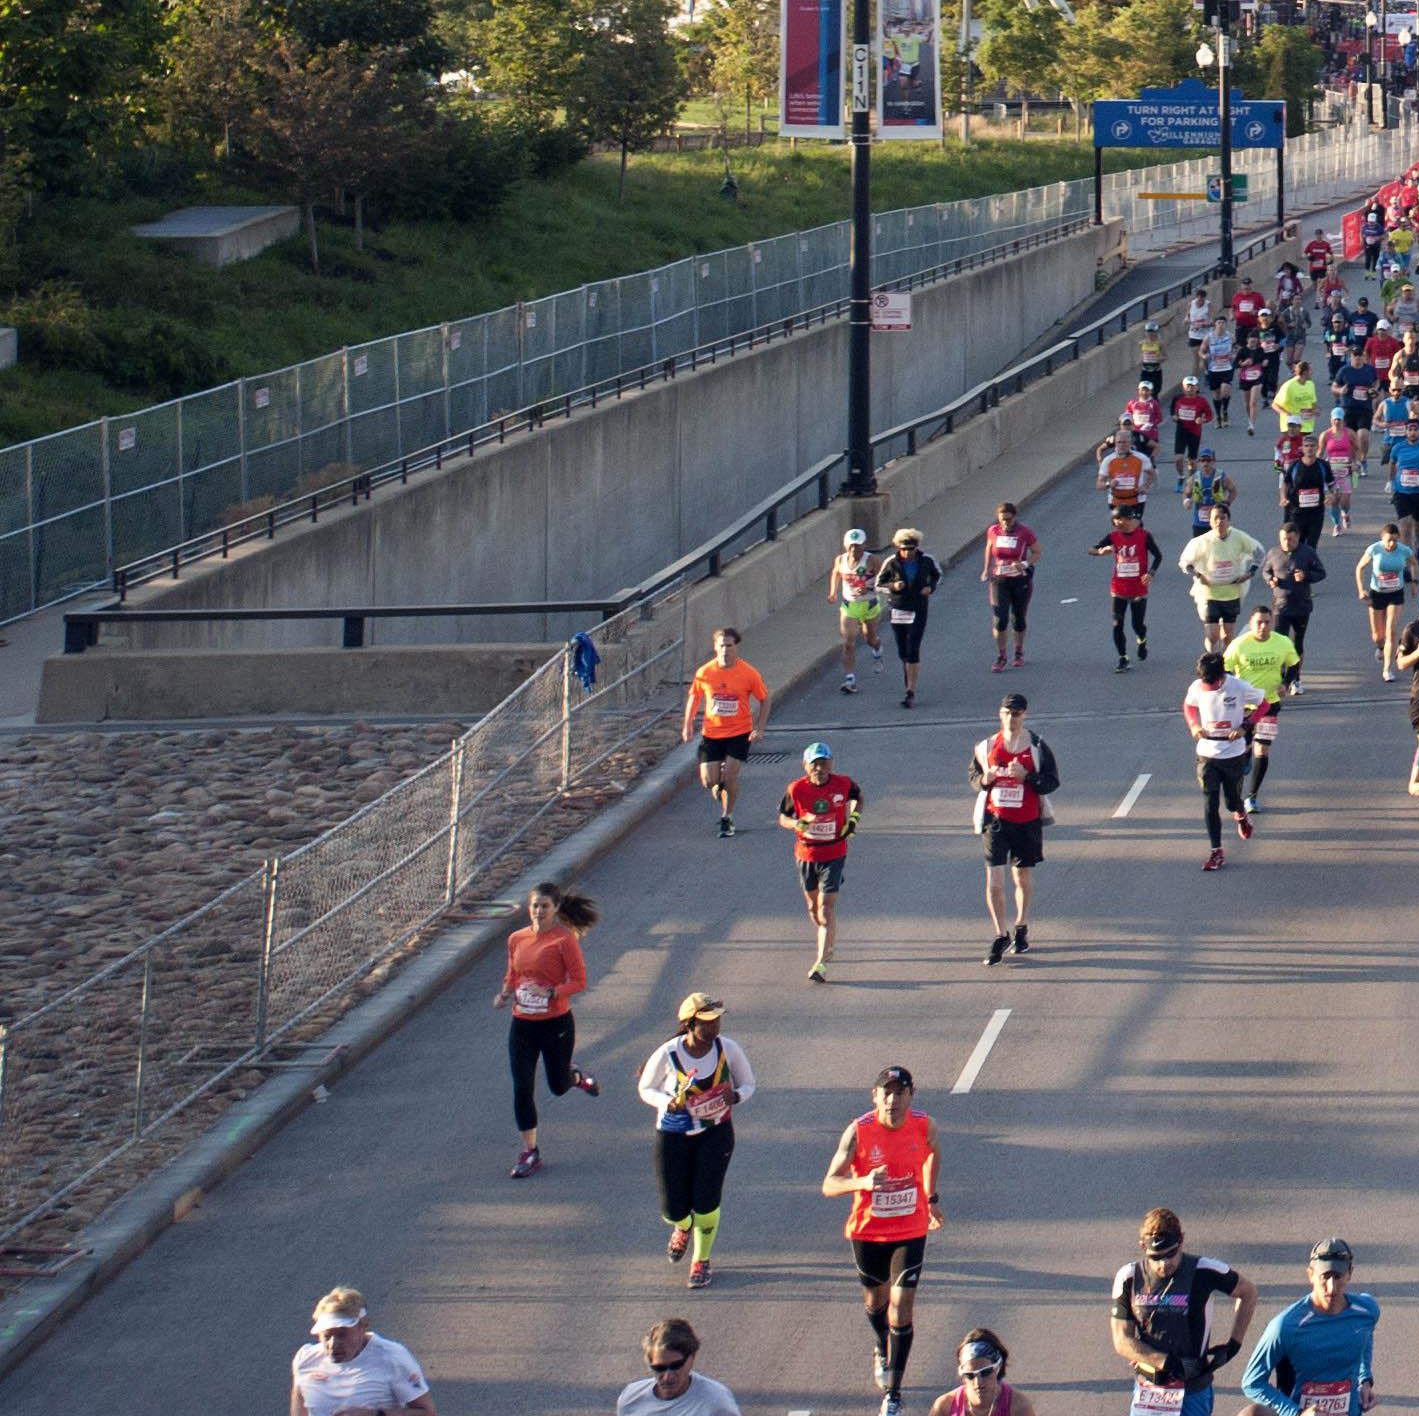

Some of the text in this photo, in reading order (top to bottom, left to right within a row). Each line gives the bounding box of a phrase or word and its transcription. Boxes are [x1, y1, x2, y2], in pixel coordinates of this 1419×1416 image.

[854, 47, 867, 109] C11N
[1127, 105, 1158, 115] TURN
[1161, 106, 1195, 115] RIGHT
[1199, 106, 1213, 115] AT
[1140, 117, 1164, 126] FOR
[1167, 117, 1218, 126] PARKING
[876, 1191, 914, 1205] E 15347
